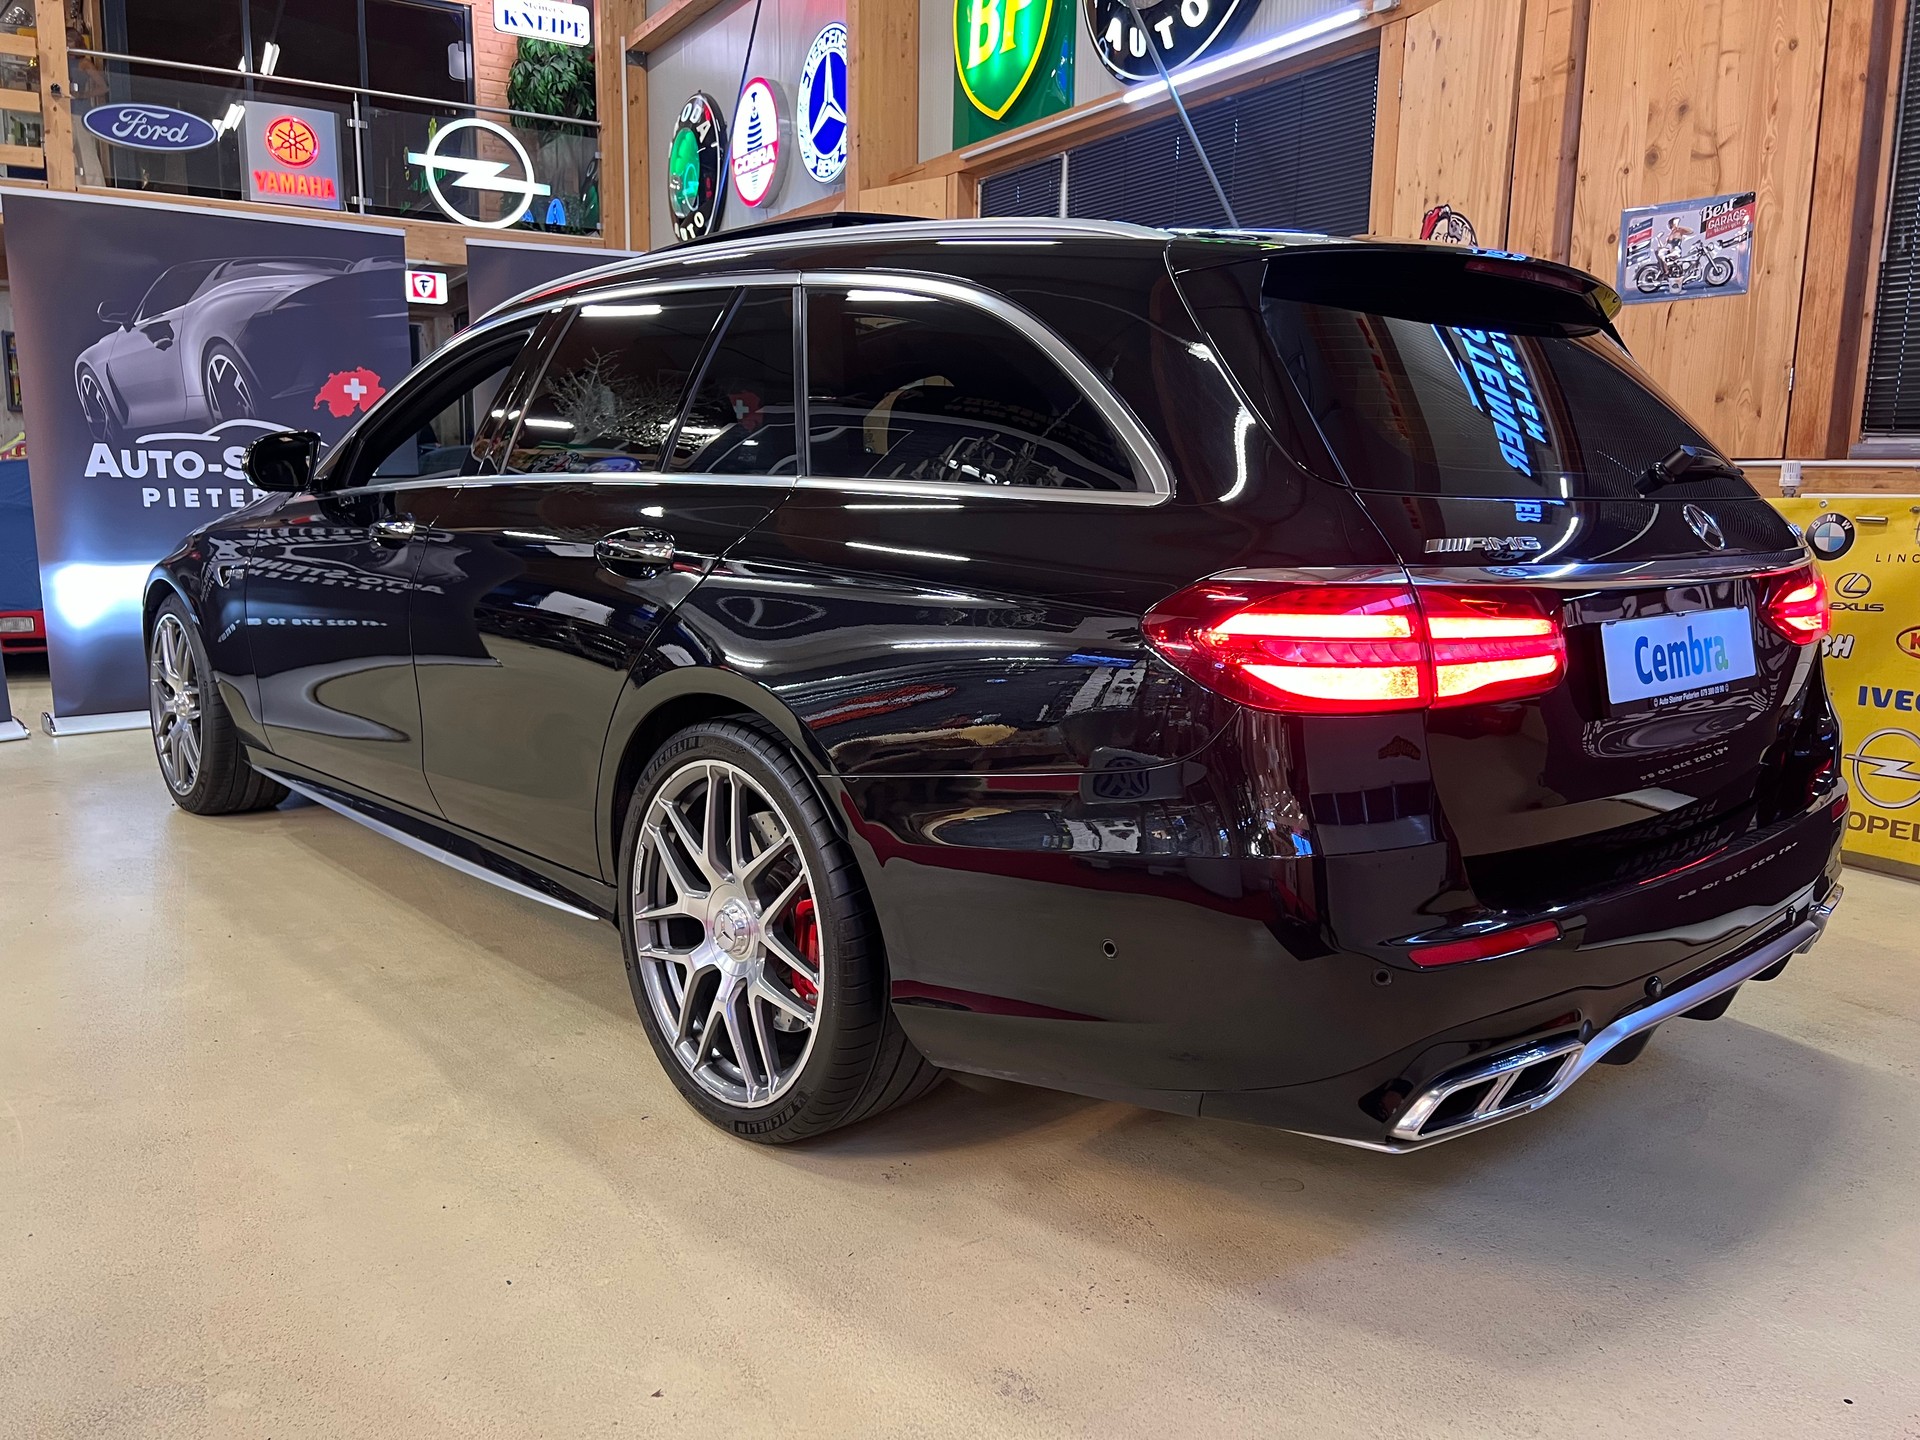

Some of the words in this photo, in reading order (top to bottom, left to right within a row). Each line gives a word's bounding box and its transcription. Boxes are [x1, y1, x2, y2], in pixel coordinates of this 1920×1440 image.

[504, 9, 585, 39] KNEIPE
[966, 0, 1033, 69] BP
[1104, 0, 1208, 58] AUTO
[111, 108, 189, 144] Ford
[734, 144, 776, 175] COBRA
[253, 170, 337, 200] YAMAHA
[1699, 198, 1737, 222] Best
[1708, 208, 1748, 230] GARAGE
[84, 442, 247, 480] AUTO-S
[1811, 514, 1853, 531] BMW
[1464, 536, 1541, 551] AMG
[1634, 626, 1729, 685] Cembra
[1659, 696, 1669, 705] Auto
[1669, 694, 1682, 704] Steiner
[1683, 690, 1700, 701] Pieterlen
[1858, 686, 1920, 711] IVE
[646, 736, 700, 778] MICHELIN
[1692, 752, 1713, 763] 032
[1848, 811, 1920, 843] OPEL
[735, 1105, 796, 1135] MICHELIN
